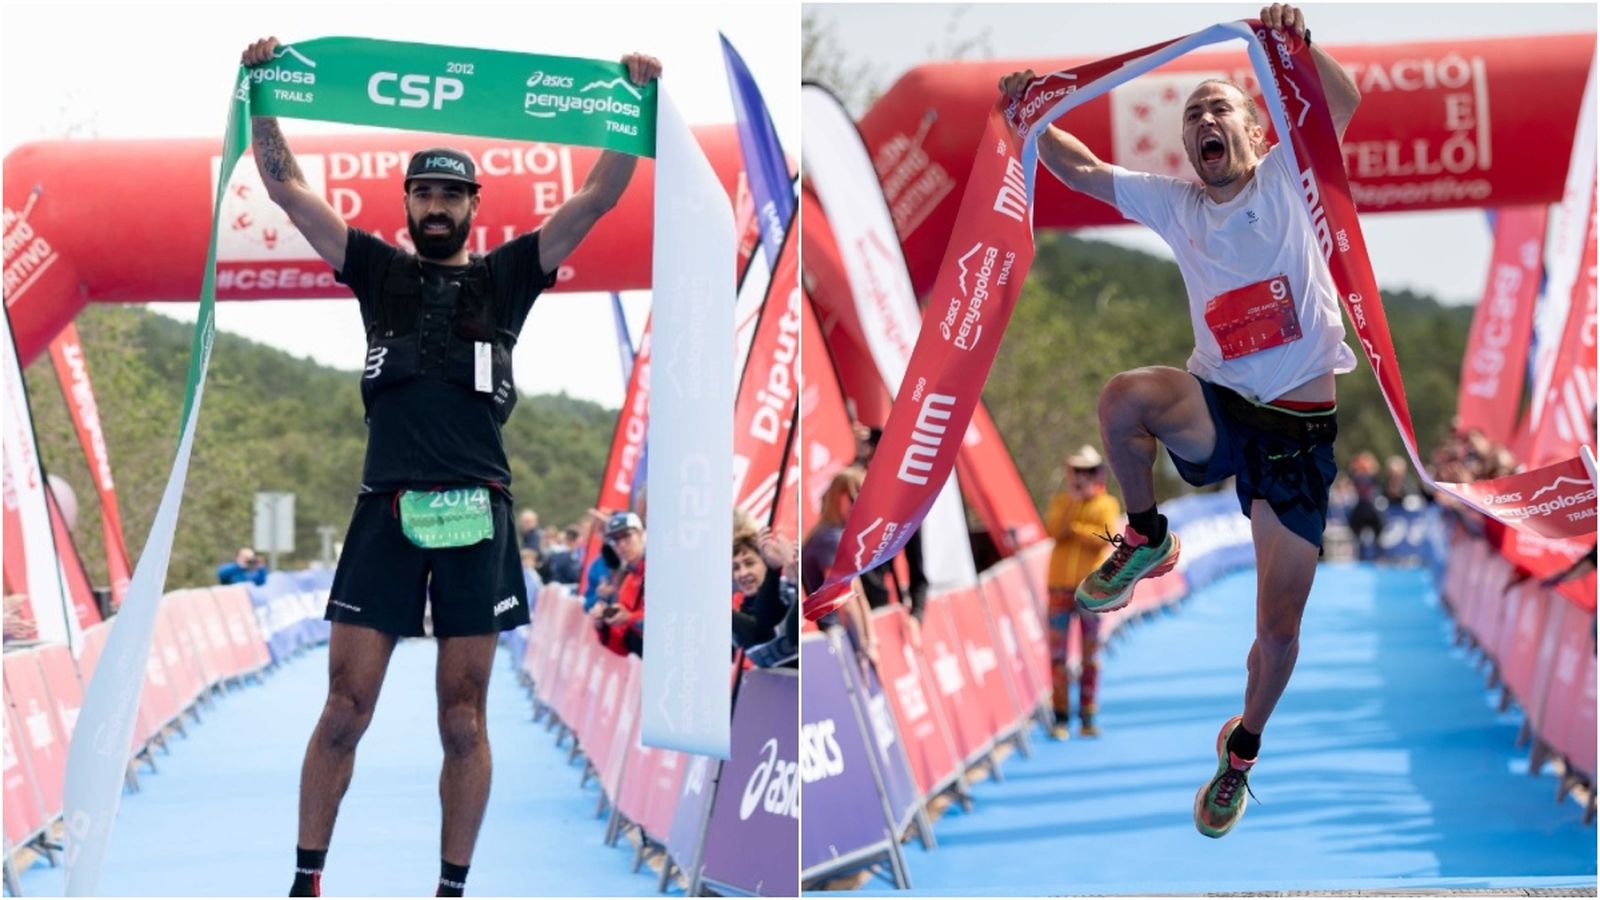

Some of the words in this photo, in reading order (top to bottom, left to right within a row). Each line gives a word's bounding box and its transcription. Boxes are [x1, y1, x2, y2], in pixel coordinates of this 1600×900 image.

[250, 66, 316, 84] golosa
[446, 61, 475, 75] 2012
[274, 89, 314, 103] TRAILS
[367, 71, 464, 110] CSP
[525, 92, 641, 118] penyagolosa
[605, 119, 638, 136] TRAILS
[425, 156, 466, 175] HOKA
[997, 251, 1015, 286] TRAILS
[954, 246, 999, 350] penyagolosa
[1269, 279, 1287, 300] 9
[911, 377, 927, 402] 1999
[897, 393, 957, 485] mim
[429, 487, 486, 509] 2014
